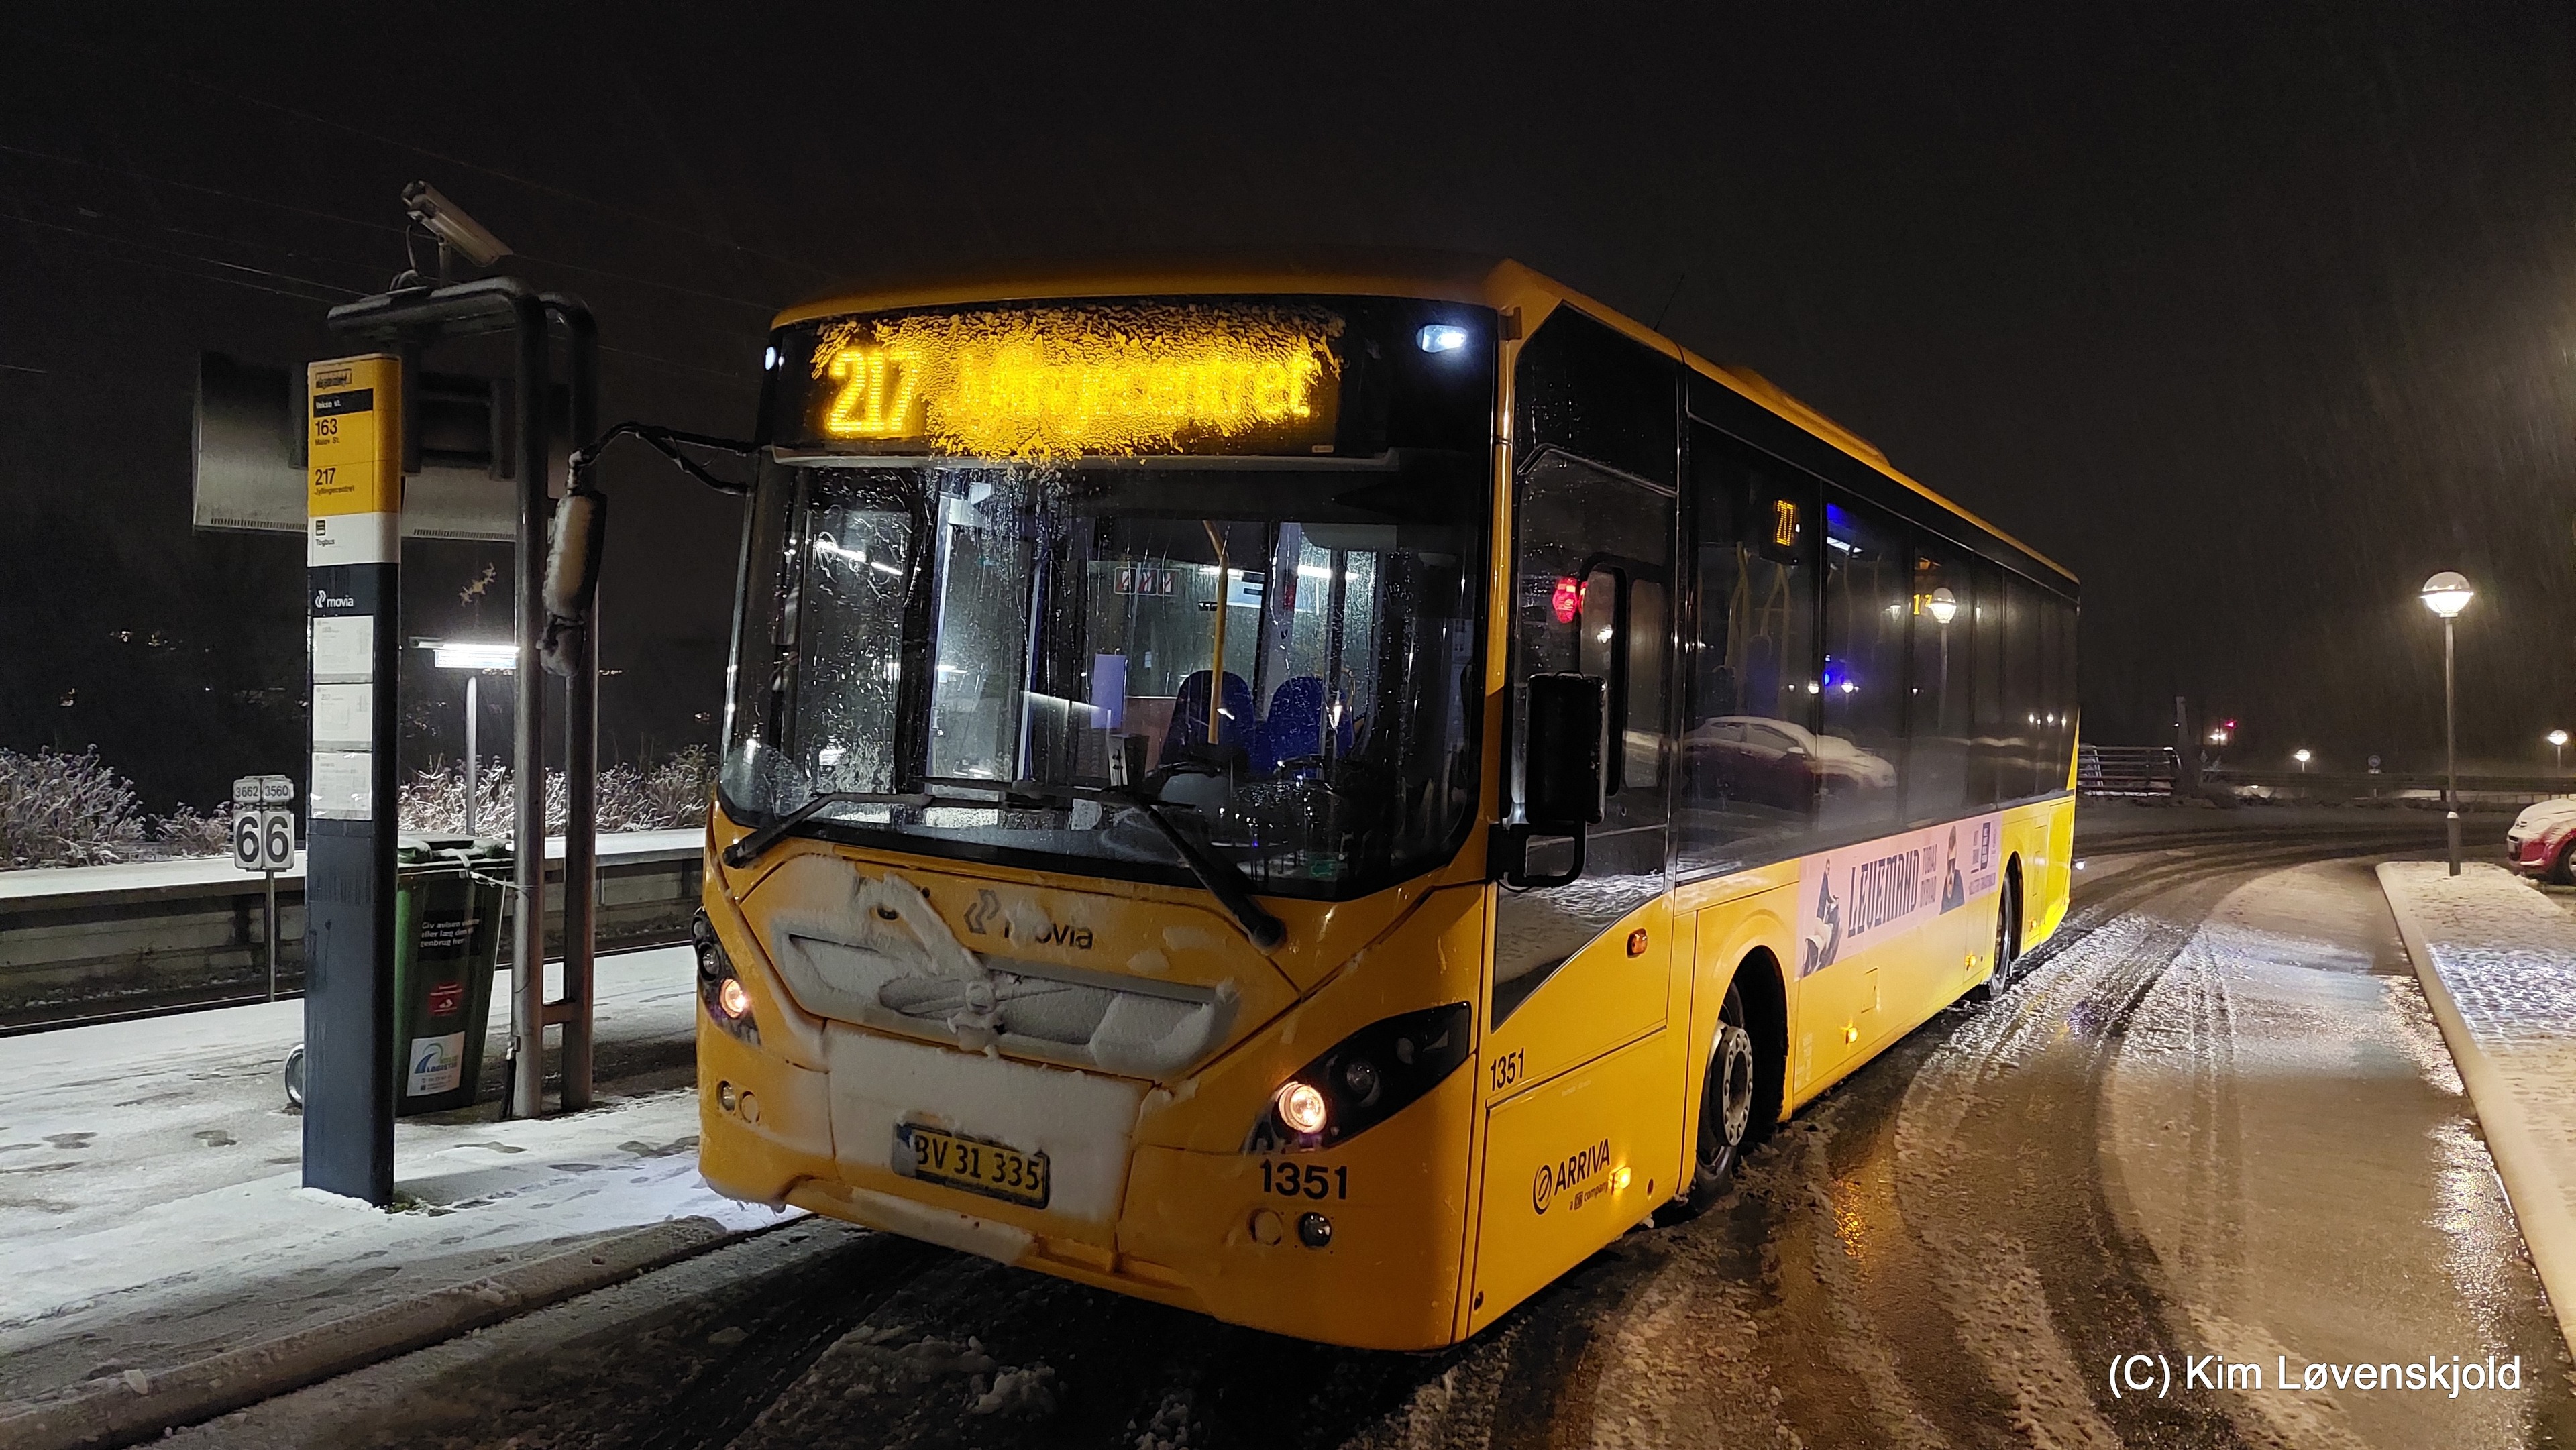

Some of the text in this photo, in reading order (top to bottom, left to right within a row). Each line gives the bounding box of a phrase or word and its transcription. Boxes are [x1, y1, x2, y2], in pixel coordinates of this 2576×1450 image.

[829, 351, 923, 432] 217
[315, 418, 338, 437] 163
[315, 467, 336, 486] 217
[327, 594, 354, 608] movia
[235, 785, 289, 798] 3662 3560
[1004, 919, 1093, 950] ovia
[1490, 1048, 1525, 1091] 1351
[915, 1135, 1040, 1190] BV 31 335
[1260, 1158, 1348, 1200] 1351
[1554, 1138, 1610, 1196] ARRIVA
